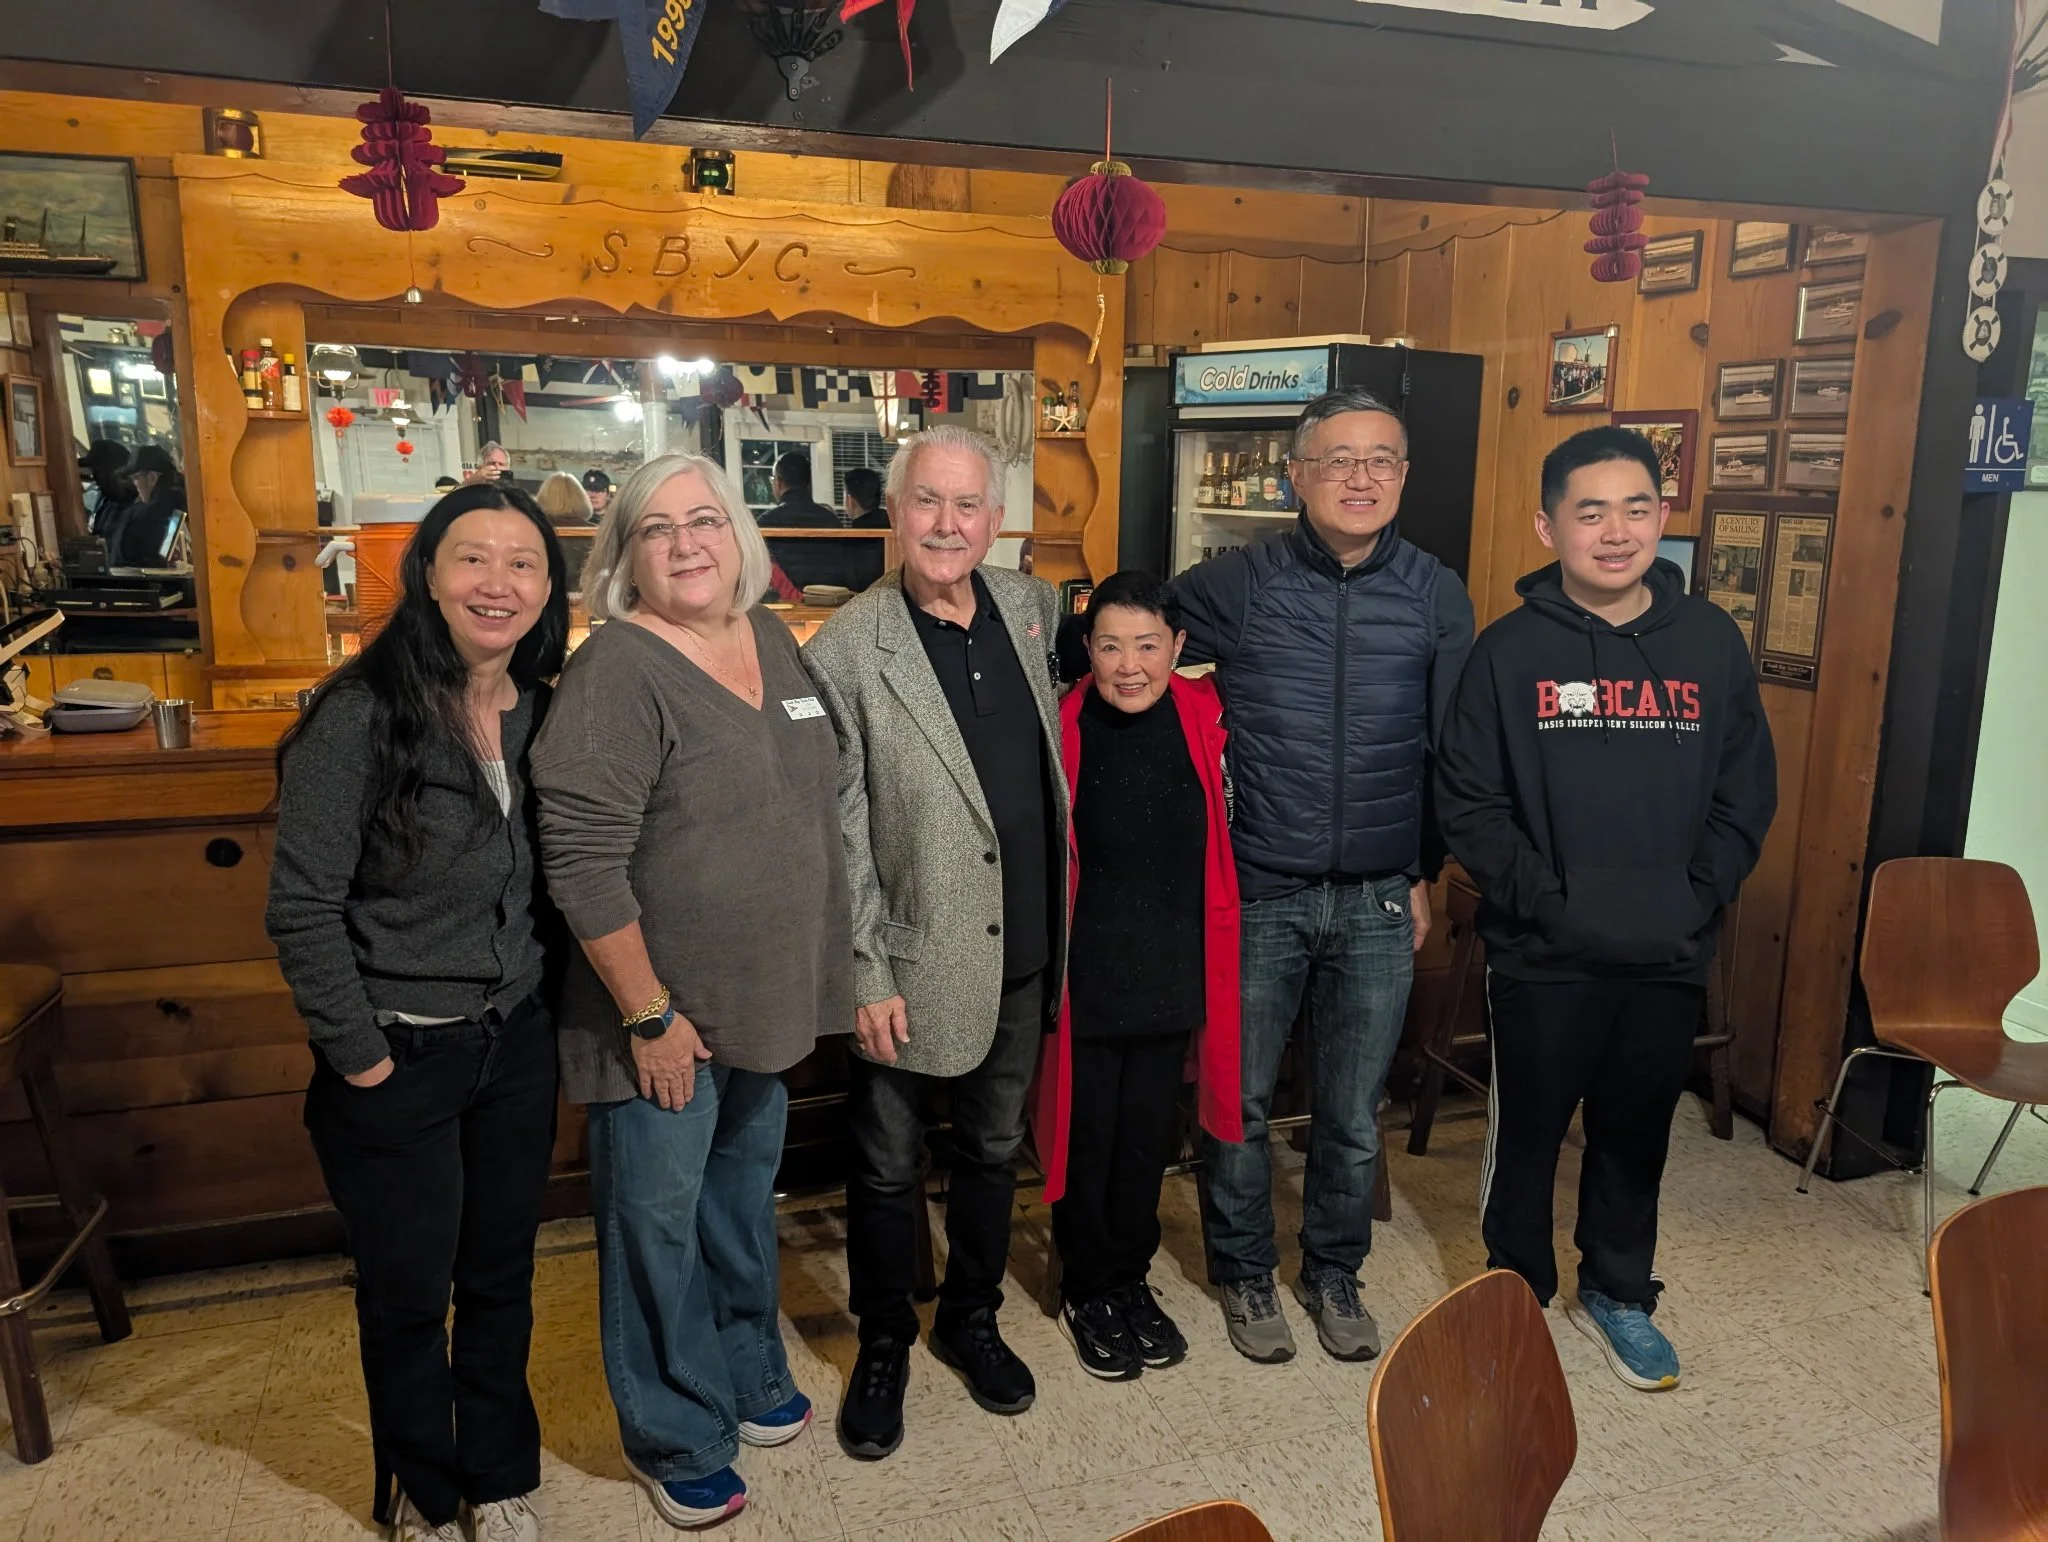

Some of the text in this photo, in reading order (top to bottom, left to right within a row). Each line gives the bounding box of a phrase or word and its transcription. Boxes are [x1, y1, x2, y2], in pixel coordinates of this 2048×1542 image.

[1200, 365, 1300, 391] Cold Drinks
[1981, 473, 2000, 482] MEN
[1719, 516, 1760, 526] A CENTURY
[1719, 524, 1759, 534] OF SAILING
[1536, 679, 1700, 720] BBCATS
[1538, 720, 1565, 730] BASIS
[1567, 719, 1627, 729] INDEPEENT
[1629, 721, 1666, 729] SILICON
